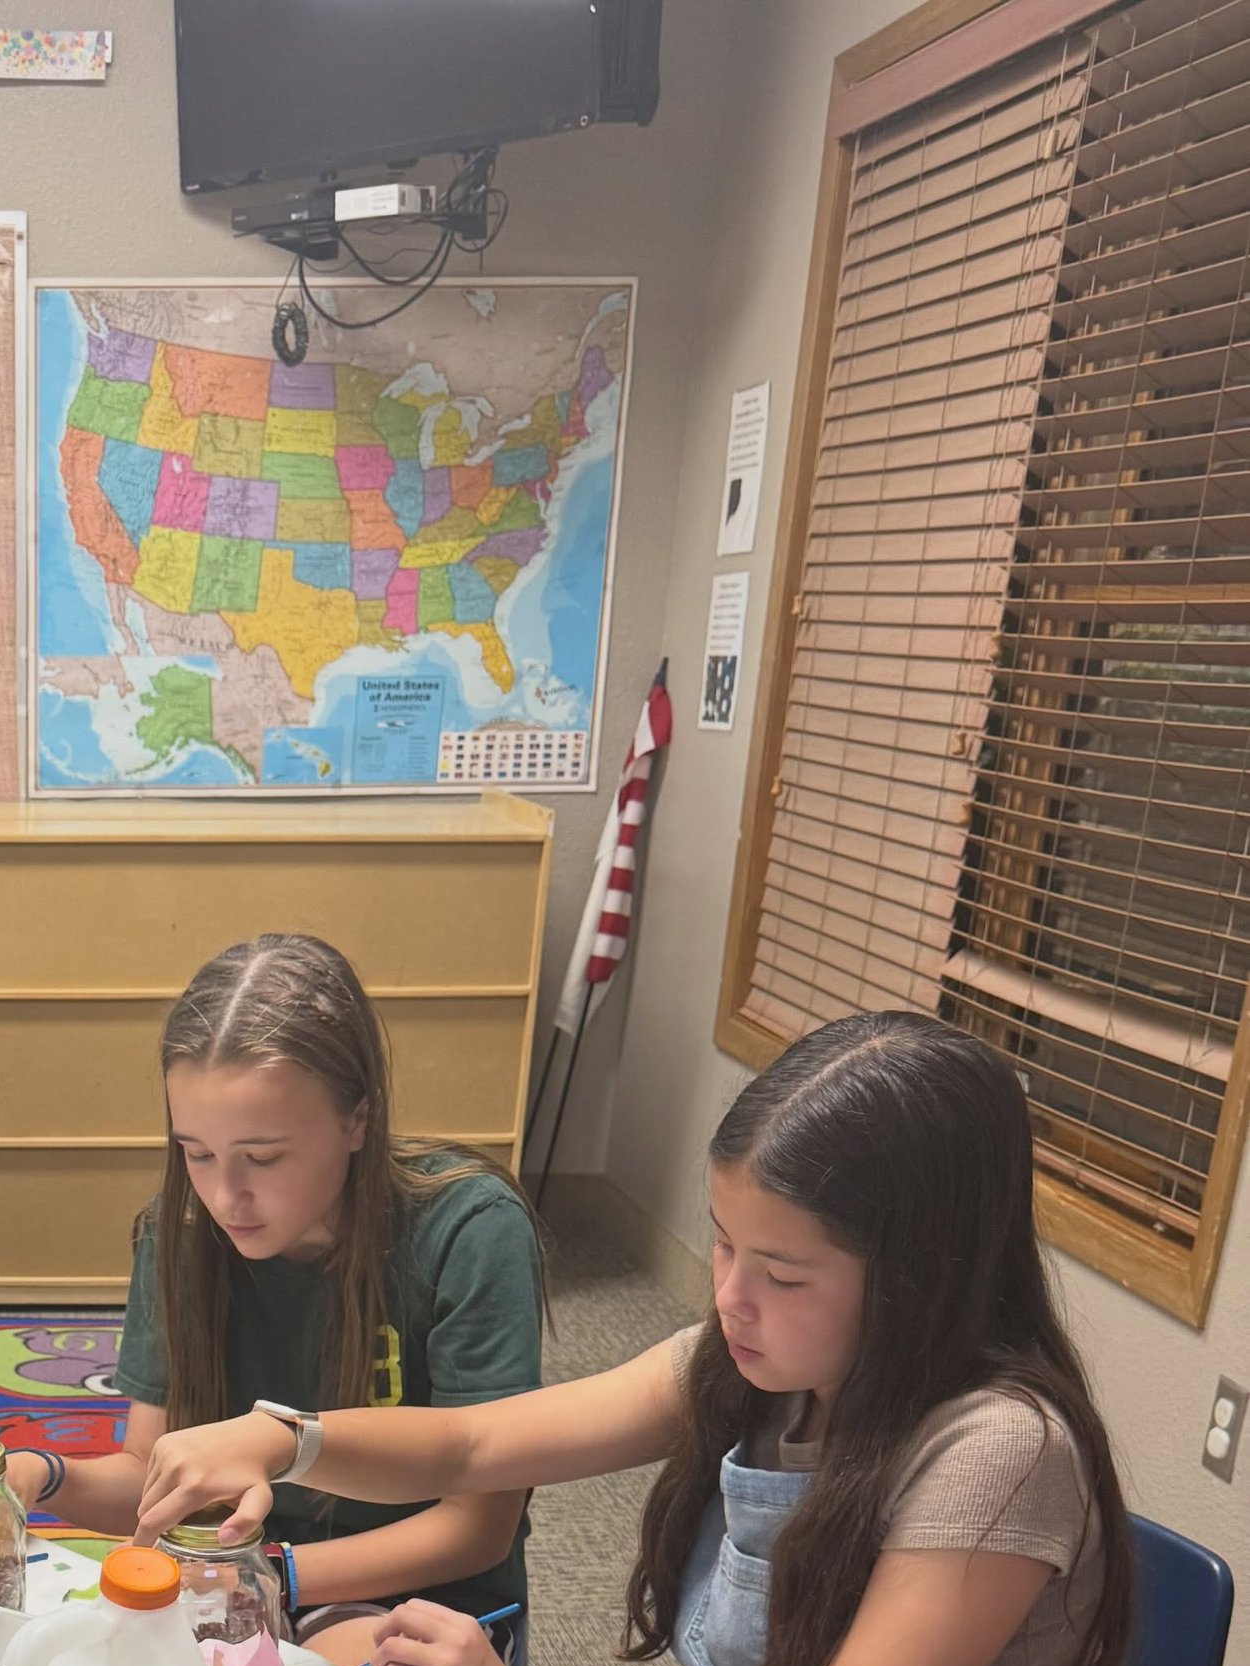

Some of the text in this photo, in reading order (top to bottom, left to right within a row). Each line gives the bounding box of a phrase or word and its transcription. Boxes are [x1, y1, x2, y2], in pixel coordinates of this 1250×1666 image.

[361, 681, 439, 691] United States
[369, 692, 431, 702] of America
